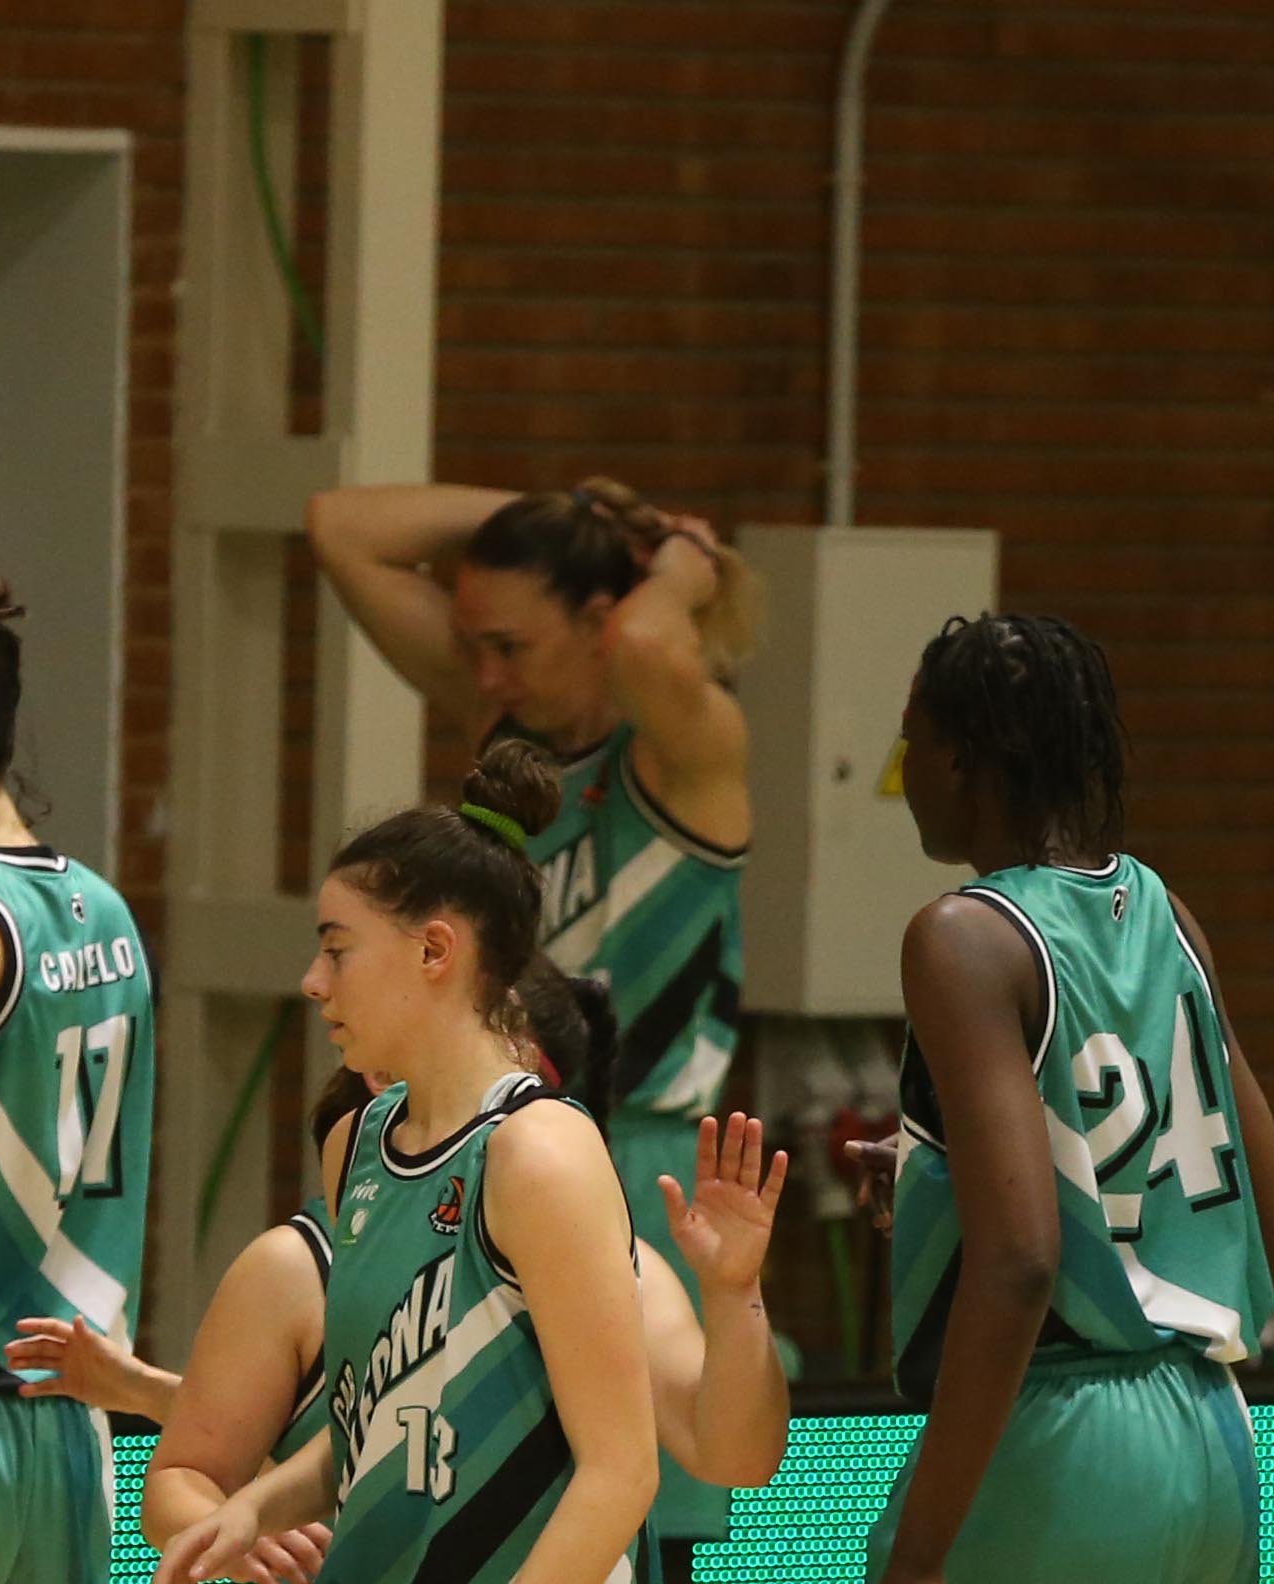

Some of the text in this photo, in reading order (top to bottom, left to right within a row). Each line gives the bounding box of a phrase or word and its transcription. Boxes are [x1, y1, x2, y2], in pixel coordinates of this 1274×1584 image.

[53, 1012, 137, 1203] 17
[1070, 992, 1241, 1243] 24
[397, 1404, 459, 1506] 13
